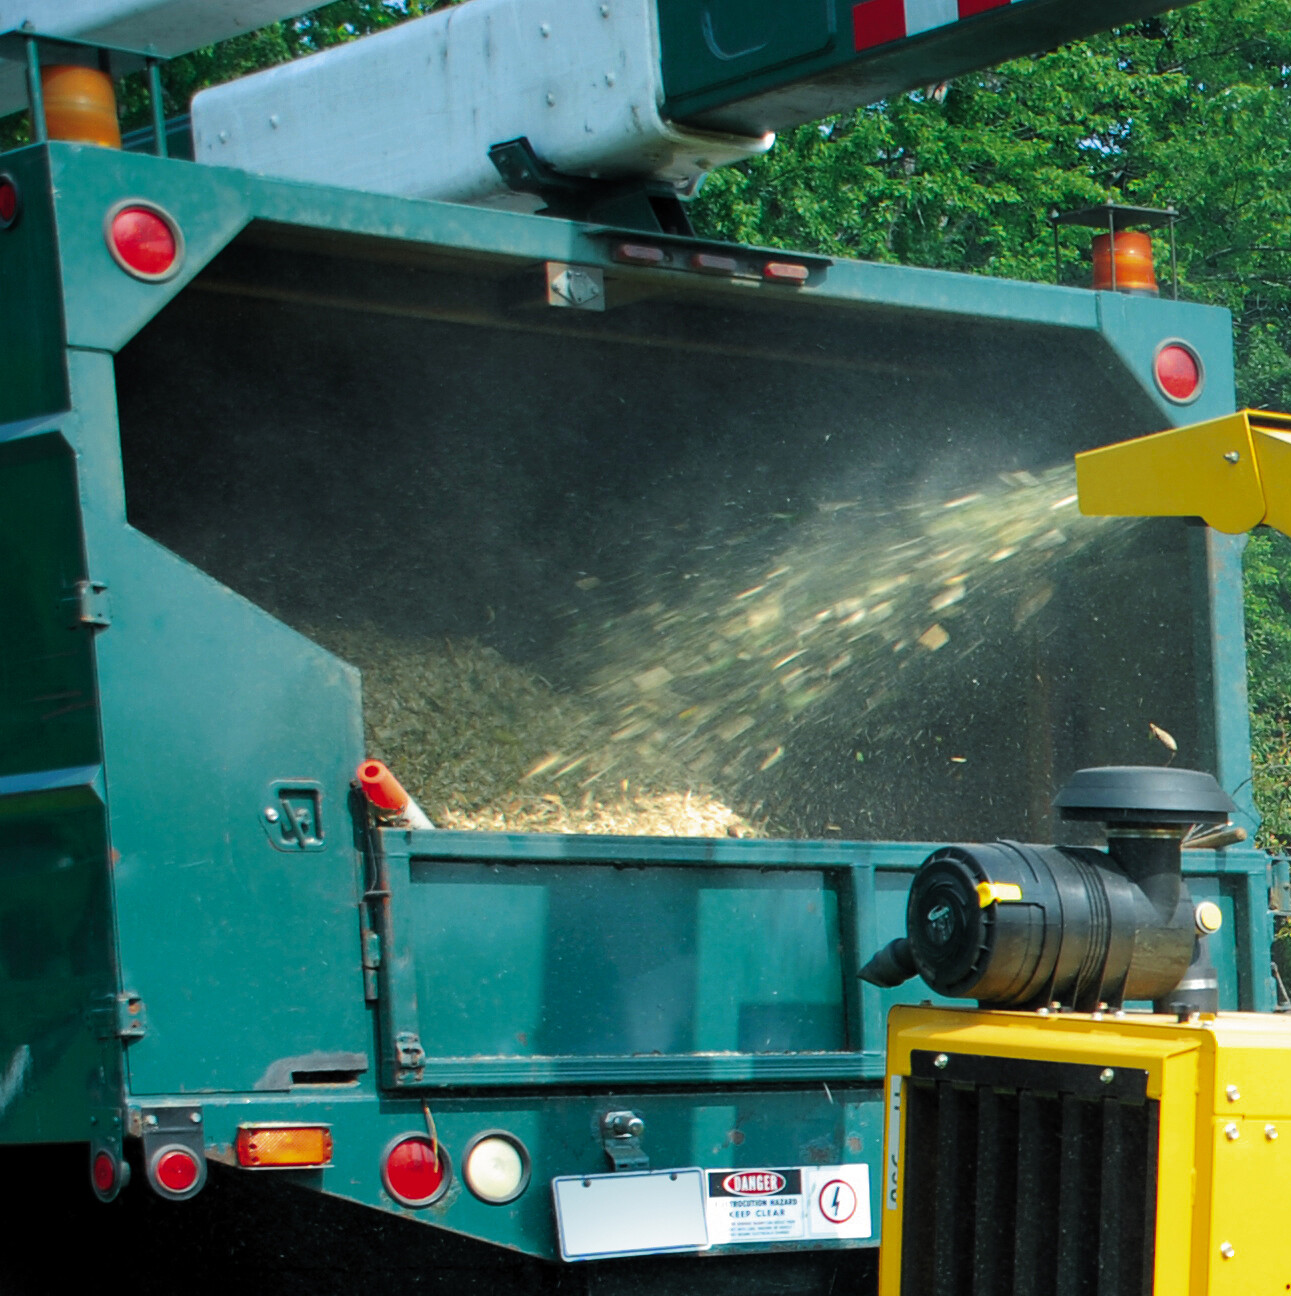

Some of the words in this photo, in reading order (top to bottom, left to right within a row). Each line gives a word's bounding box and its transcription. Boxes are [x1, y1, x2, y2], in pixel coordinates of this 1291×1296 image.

[734, 1175, 778, 1191] DANGER
[770, 1198, 798, 1207] HAZARD
[729, 1210, 751, 1218] KEEP
[756, 1209, 785, 1217] CLEAR
